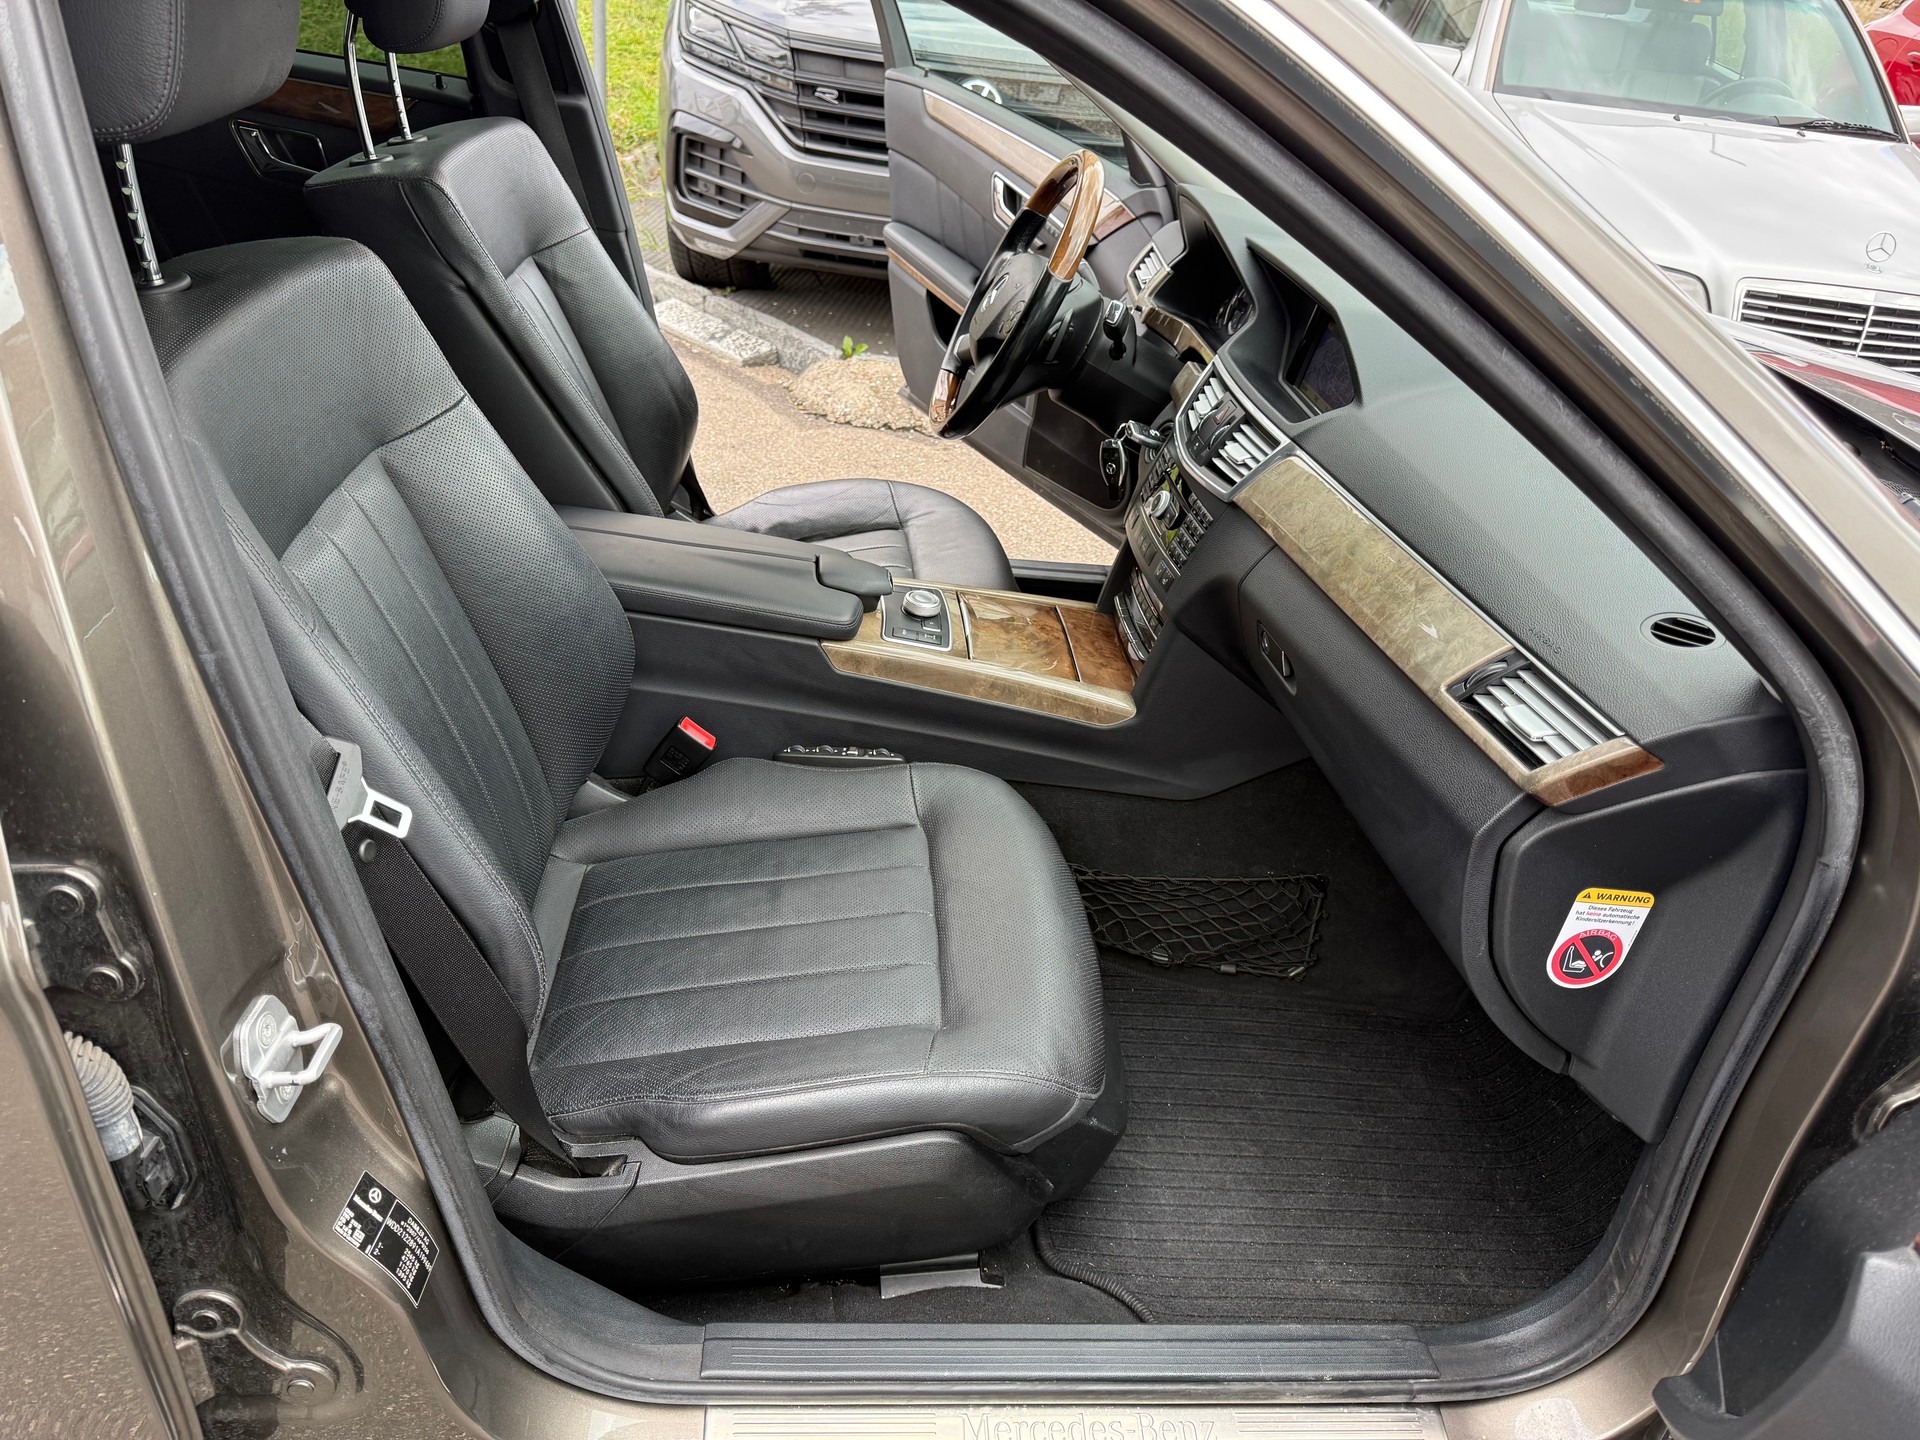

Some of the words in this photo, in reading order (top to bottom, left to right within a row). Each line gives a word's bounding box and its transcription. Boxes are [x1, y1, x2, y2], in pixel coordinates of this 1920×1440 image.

[1596, 892, 1651, 904] WARNUNG
[1602, 912, 1640, 920] automatische
[1608, 906, 1634, 914] Fahrzeug
[1579, 929, 1618, 941] AIRBAG
[959, 1412, 1215, 1440] Mercedes-Benz
